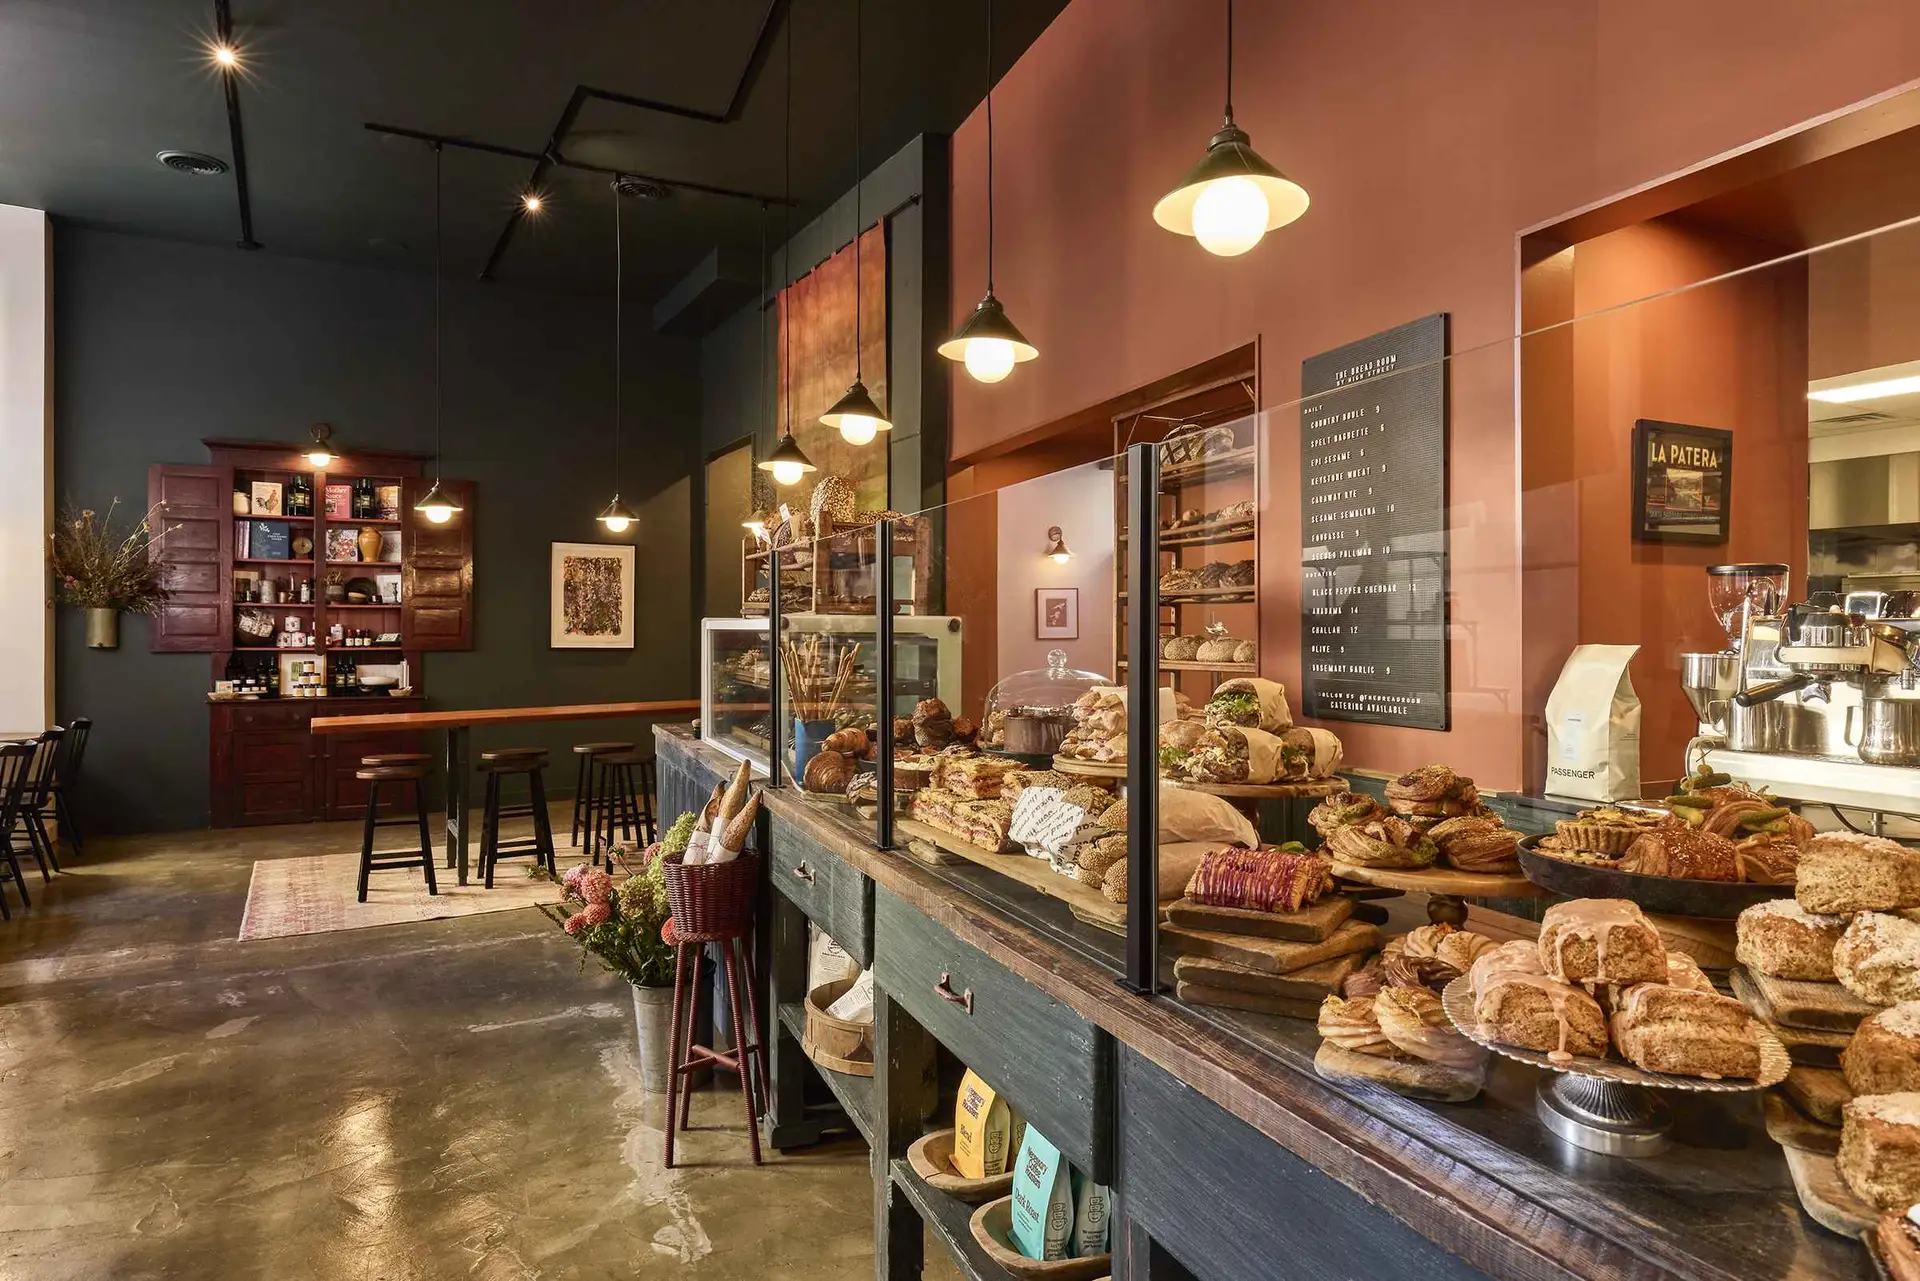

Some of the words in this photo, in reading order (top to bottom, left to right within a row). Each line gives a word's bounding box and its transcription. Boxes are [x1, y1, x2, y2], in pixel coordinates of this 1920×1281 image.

[1335, 370, 1348, 380] THE
[1351, 361, 1373, 375] BREAD
[1376, 355, 1397, 366] ROOM
[1336, 379, 1345, 387] BY
[1368, 364, 1396, 377] STREET
[1304, 404, 1323, 414] DAILY
[1310, 415, 1340, 429] COUNTRY
[1342, 408, 1365, 421] BOULE
[1310, 436, 1331, 448] SPELT
[1333, 427, 1369, 443] BAGUETTE
[1310, 458, 1322, 467] EPI
[1324, 451, 1351, 464] SESAME
[1651, 442, 1667, 463] LA
[1670, 444, 1718, 468] PATERA
[1311, 472, 1344, 486] KEYSTONE
[1347, 467, 1371, 479] WHEAT
[1311, 492, 1342, 505] CARAWAY
[1344, 489, 1357, 499] RYE
[1311, 512, 1337, 524] SESAME
[1340, 507, 1376, 519] SEMOLINA
[1311, 531, 1345, 542] FOUGASSE
[1339, 547, 1372, 558] PULLMAN
[1305, 570, 1337, 578] ROTATING
[1312, 588, 1333, 597] BLACK
[1335, 586, 1361, 596] PEPPER
[1364, 584, 1397, 594] CHEDDAR
[1312, 607, 1342, 615] ANADAMA
[1350, 606, 1359, 614] 14
[1311, 626, 1341, 634] CHALLAH
[1350, 626, 1359, 634] 12
[1311, 645, 1331, 653] OLIVE
[1312, 664, 1346, 673] ROSEMARY
[1349, 665, 1375, 674] GARLIC
[1330, 701, 1364, 711] CATERING
[1366, 704, 1408, 715] AVAILABLE
[1551, 766, 1596, 779] PASSENGER
[1015, 1187, 1028, 1206] Dark
